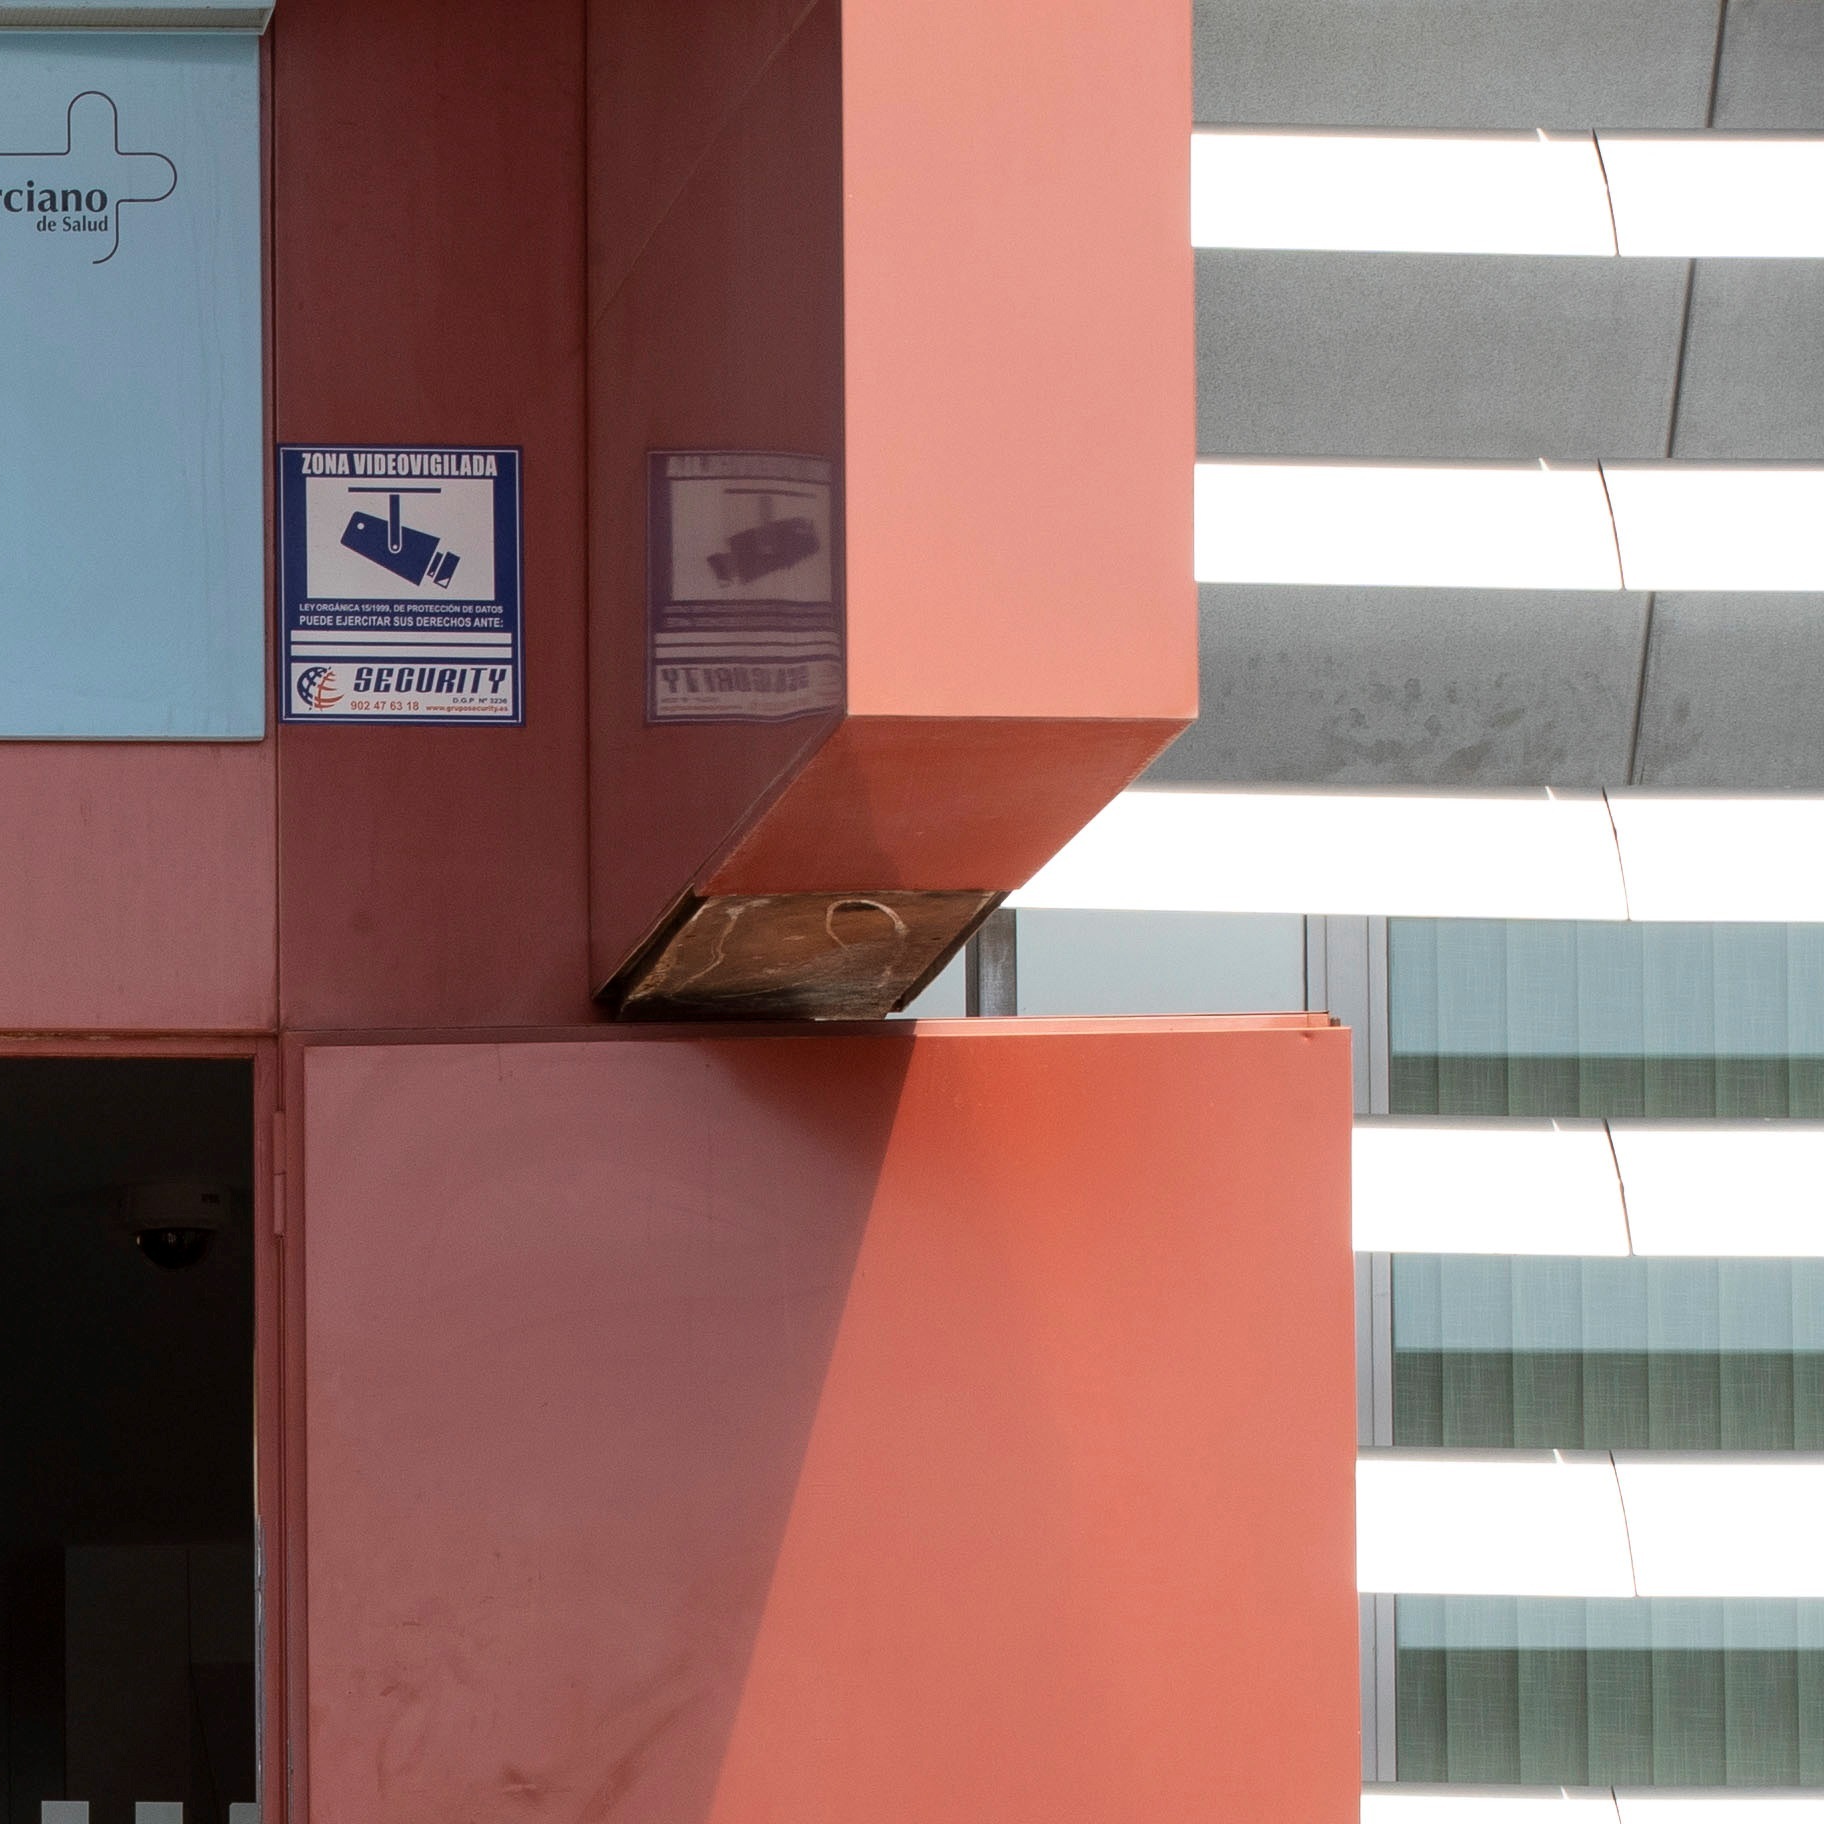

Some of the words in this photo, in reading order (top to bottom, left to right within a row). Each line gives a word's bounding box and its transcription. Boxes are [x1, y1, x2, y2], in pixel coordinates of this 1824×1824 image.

[36, 215, 57, 232] de
[62, 215, 108, 232] Salud
[302, 453, 350, 474] ZONA
[353, 453, 498, 477] VIDEOVIGILADA
[299, 603, 316, 612] LEY
[393, 604, 405, 613] DE
[407, 604, 460, 613] PROTECCIÓN
[462, 605, 474, 613] DE
[475, 605, 504, 613] DATOS
[299, 615, 334, 626] PUEDE
[336, 615, 391, 626] EJERCITAR
[393, 616, 414, 627] SUS
[416, 617, 472, 627] DERECHOS
[473, 617, 504, 628] ANTE:
[353, 667, 507, 694] SECURITY
[350, 701, 370, 711] 902
[373, 701, 386, 711] 47
[390, 701, 403, 711] 63
[406, 701, 420, 711] 18
